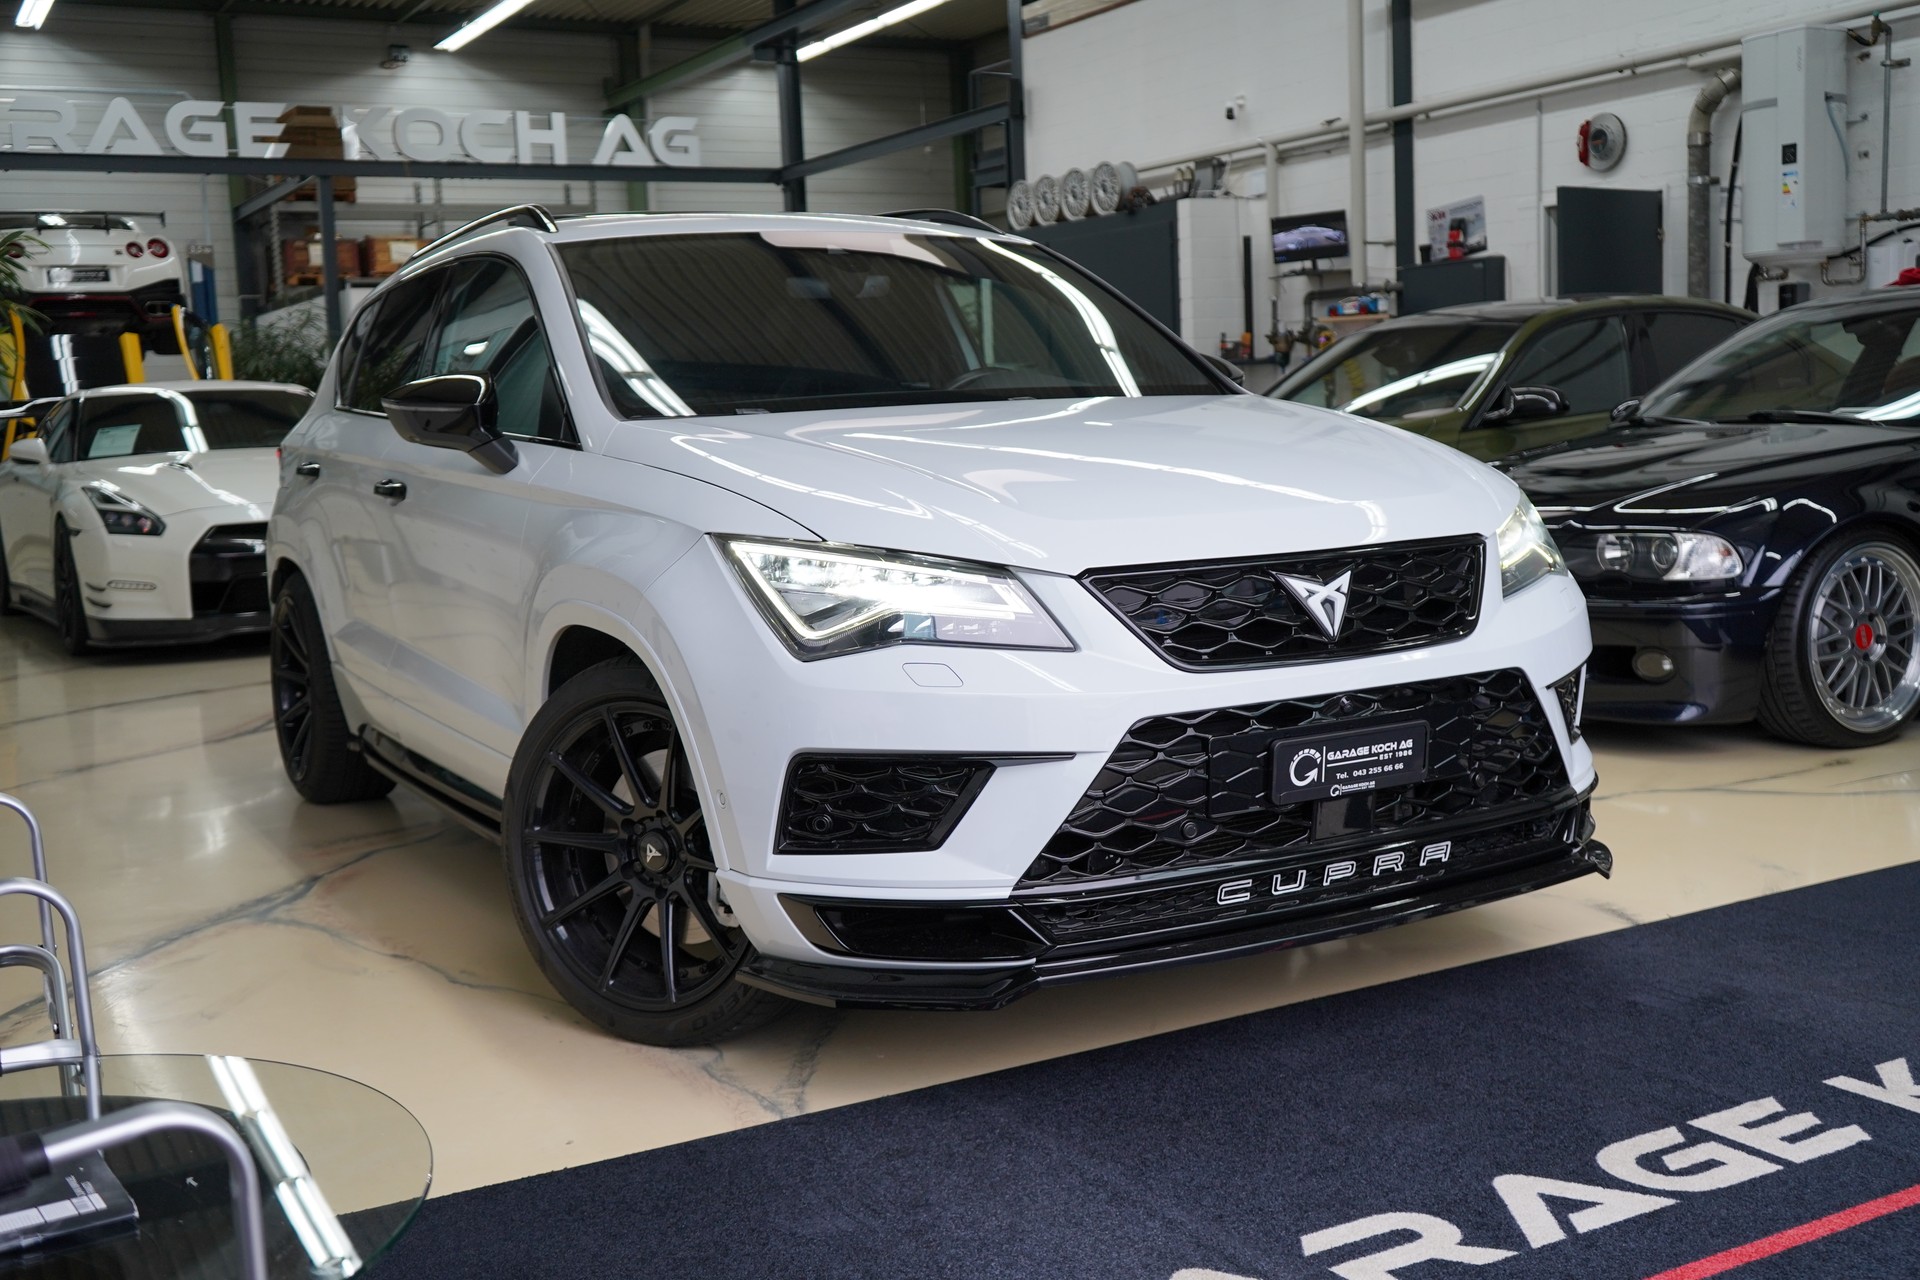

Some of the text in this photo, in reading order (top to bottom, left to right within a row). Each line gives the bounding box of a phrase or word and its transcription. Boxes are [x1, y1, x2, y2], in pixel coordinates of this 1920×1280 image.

[7, 95, 699, 168] RAGE KOCH AG
[1327, 739, 1413, 760] GARAGE KOCH AG
[1336, 762, 1404, 780] Tel. 043 255 66 66
[1217, 841, 1451, 904] CUPRA
[1168, 1095, 1873, 1280] RAGE
